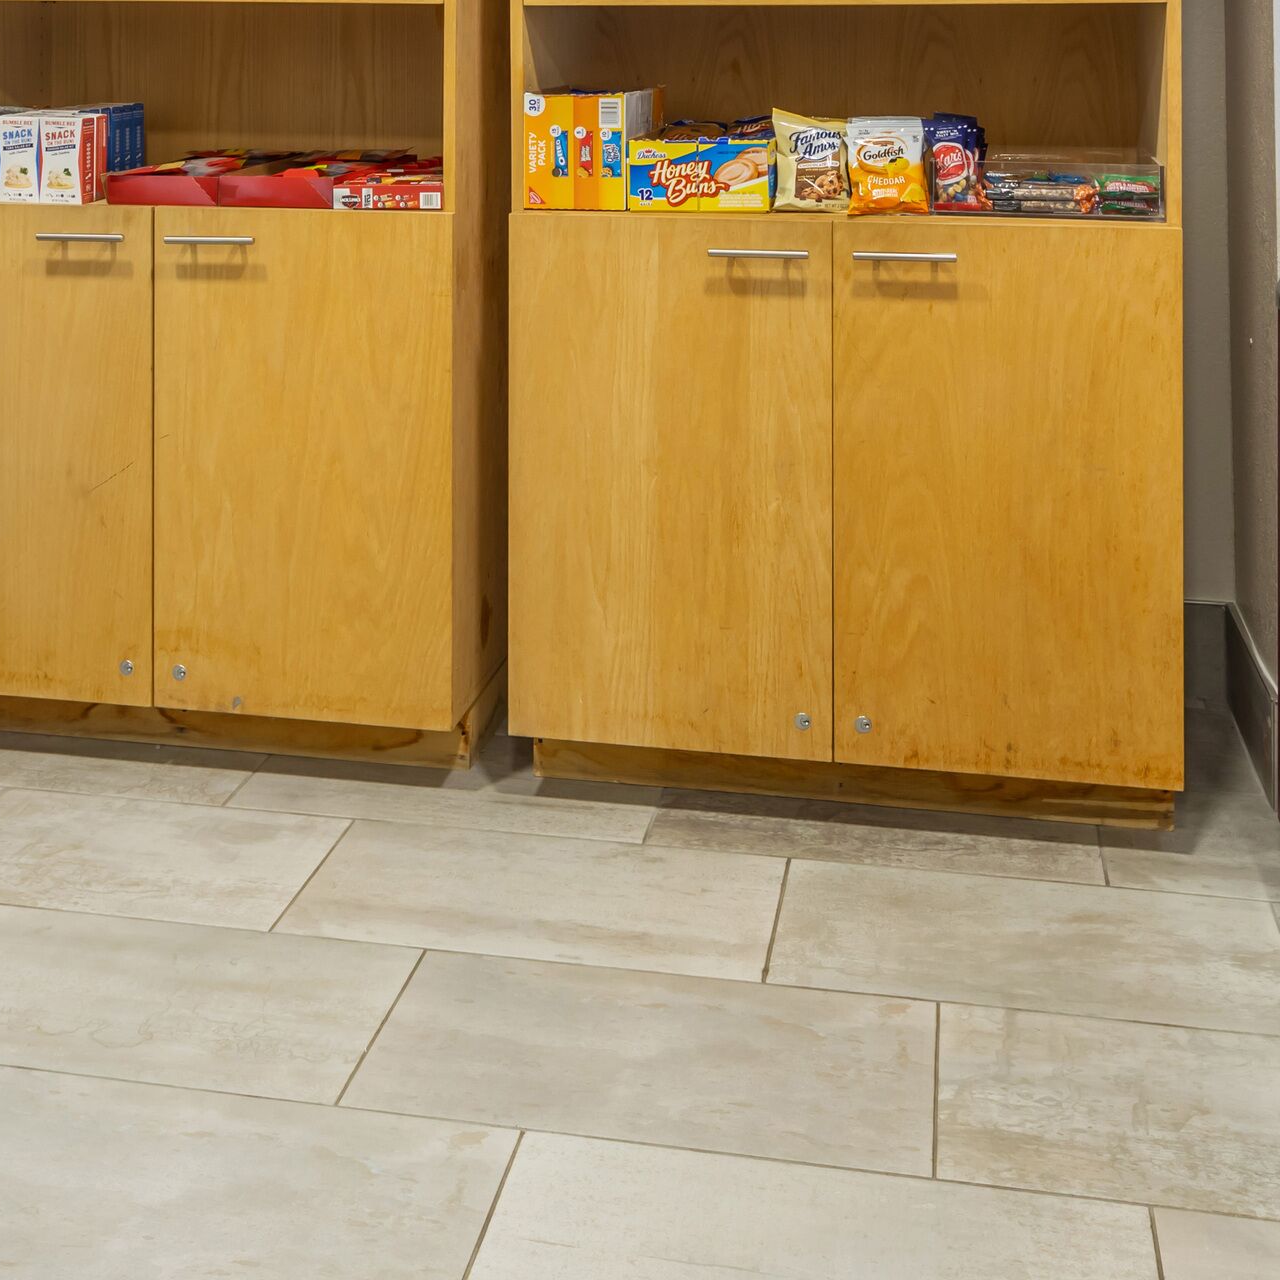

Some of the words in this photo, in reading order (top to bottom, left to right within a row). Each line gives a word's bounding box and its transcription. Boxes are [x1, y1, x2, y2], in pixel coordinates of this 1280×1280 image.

[528, 99, 537, 112] 30
[2, 128, 33, 140] SNACK
[45, 129, 76, 141] SNACK
[789, 129, 842, 153] Famous
[528, 132, 537, 174] VARIETY
[537, 139, 546, 166] PACK
[555, 139, 566, 166] OREO
[636, 150, 667, 160] Duchess
[802, 142, 839, 157] Amos
[862, 146, 905, 162] Goldfish
[651, 159, 710, 185] Honey
[866, 175, 906, 185] CHEDDAR
[637, 188, 654, 201] 12
[668, 179, 722, 203] Buns
